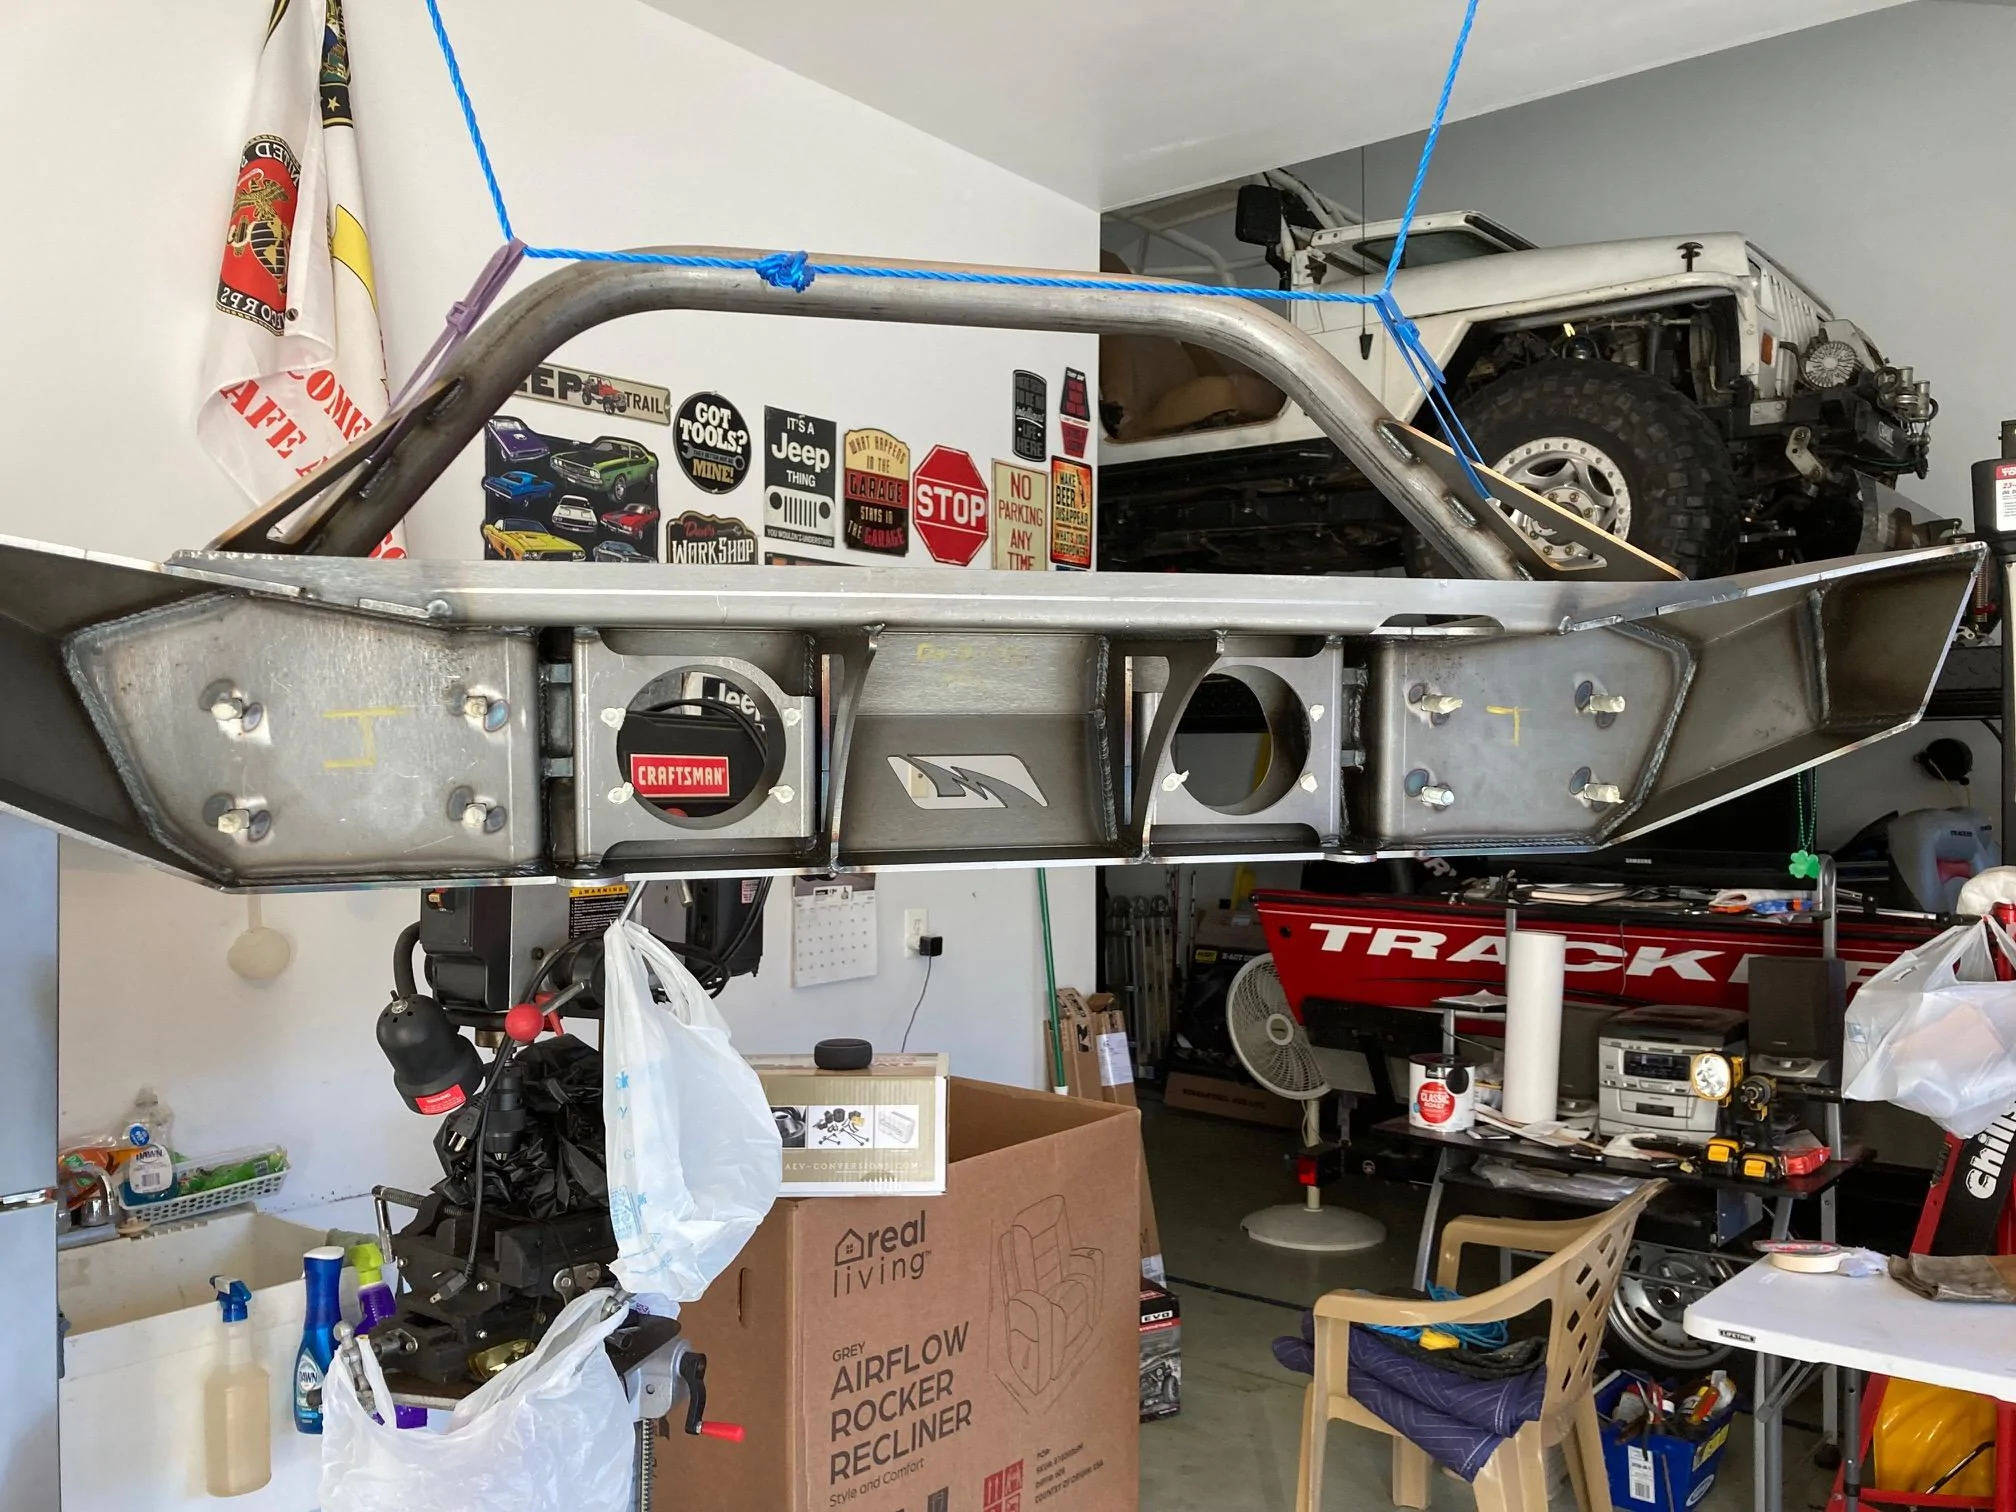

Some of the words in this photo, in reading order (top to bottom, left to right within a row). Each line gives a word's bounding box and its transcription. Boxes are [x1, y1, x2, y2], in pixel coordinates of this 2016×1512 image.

[624, 391, 664, 414] TRAIL
[695, 402, 732, 430] GOT
[787, 417, 806, 432] IT'S
[808, 422, 815, 435] A
[680, 418, 749, 454] TOOLS?
[771, 432, 830, 473] Jeep
[849, 436, 870, 455] WHAT
[874, 436, 907, 465] HAPPENS
[692, 458, 734, 484] MINE!
[878, 458, 890, 473] THE
[786, 470, 816, 488] THING
[849, 473, 903, 504] GARAGE
[1010, 471, 1031, 501] NO
[1060, 472, 1076, 488] MAKE
[916, 484, 987, 528] STOP
[1056, 485, 1076, 508] BEER
[860, 506, 883, 523] STAYS
[999, 499, 1043, 527] PARKING
[1055, 506, 1088, 526] DISAPPEAR
[766, 528, 779, 537] YOU
[847, 520, 863, 539] THE
[864, 527, 905, 548] GARAGE
[1010, 528, 1033, 551] ANY
[672, 537, 754, 565] WORKSHOP
[1007, 551, 1036, 571] TIME
[638, 765, 724, 786] CRAFTSMAN
[1310, 921, 1888, 992] TRACK
[1421, 1092, 1450, 1104] CLASSIC
[136, 1149, 163, 1161] DAWN
[867, 1209, 926, 1258] real
[833, 1251, 925, 1298] living
[1144, 1311, 1170, 1322] EVO
[1722, 1330, 1752, 1341] LIFETIME
[830, 1321, 969, 1401] AIRFLOW
[832, 1341, 866, 1362] GREY
[831, 1368, 954, 1442] ROCKER
[830, 1399, 972, 1485] RECLINER
[829, 1487, 857, 1508] Style
[859, 1475, 881, 1495] and
[883, 1456, 926, 1484] Comfort
